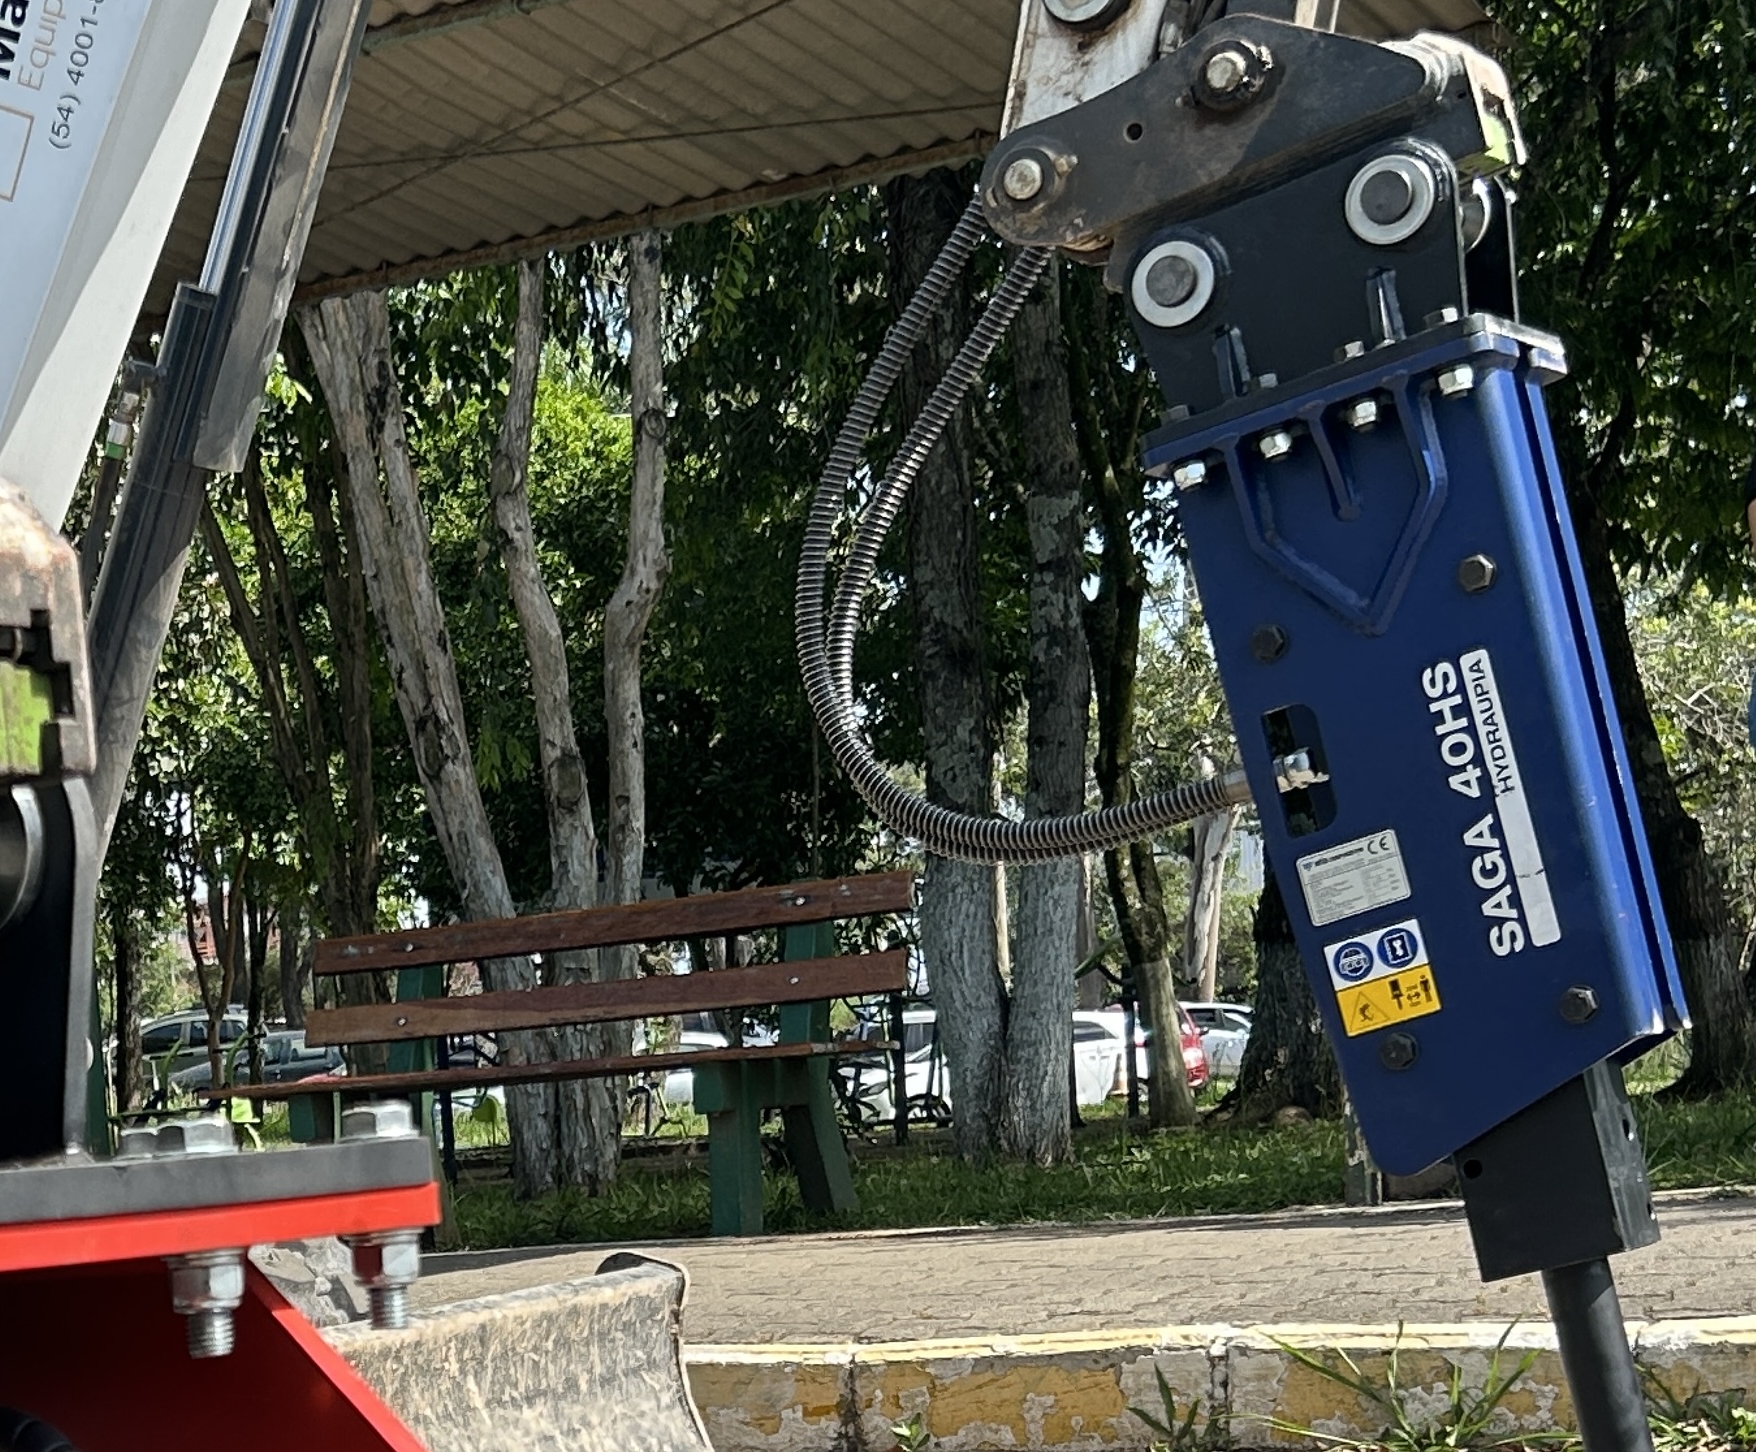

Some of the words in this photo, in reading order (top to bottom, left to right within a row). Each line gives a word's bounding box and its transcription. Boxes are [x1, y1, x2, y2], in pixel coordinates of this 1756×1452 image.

[17, 0, 66, 91] Equip
[48, 94, 81, 150] (54)
[66, 0, 105, 87] 4001-
[1422, 661, 1482, 799] 40HS
[1469, 658, 1517, 794] HYDRAUPIA
[1461, 813, 1525, 957] SAGA
